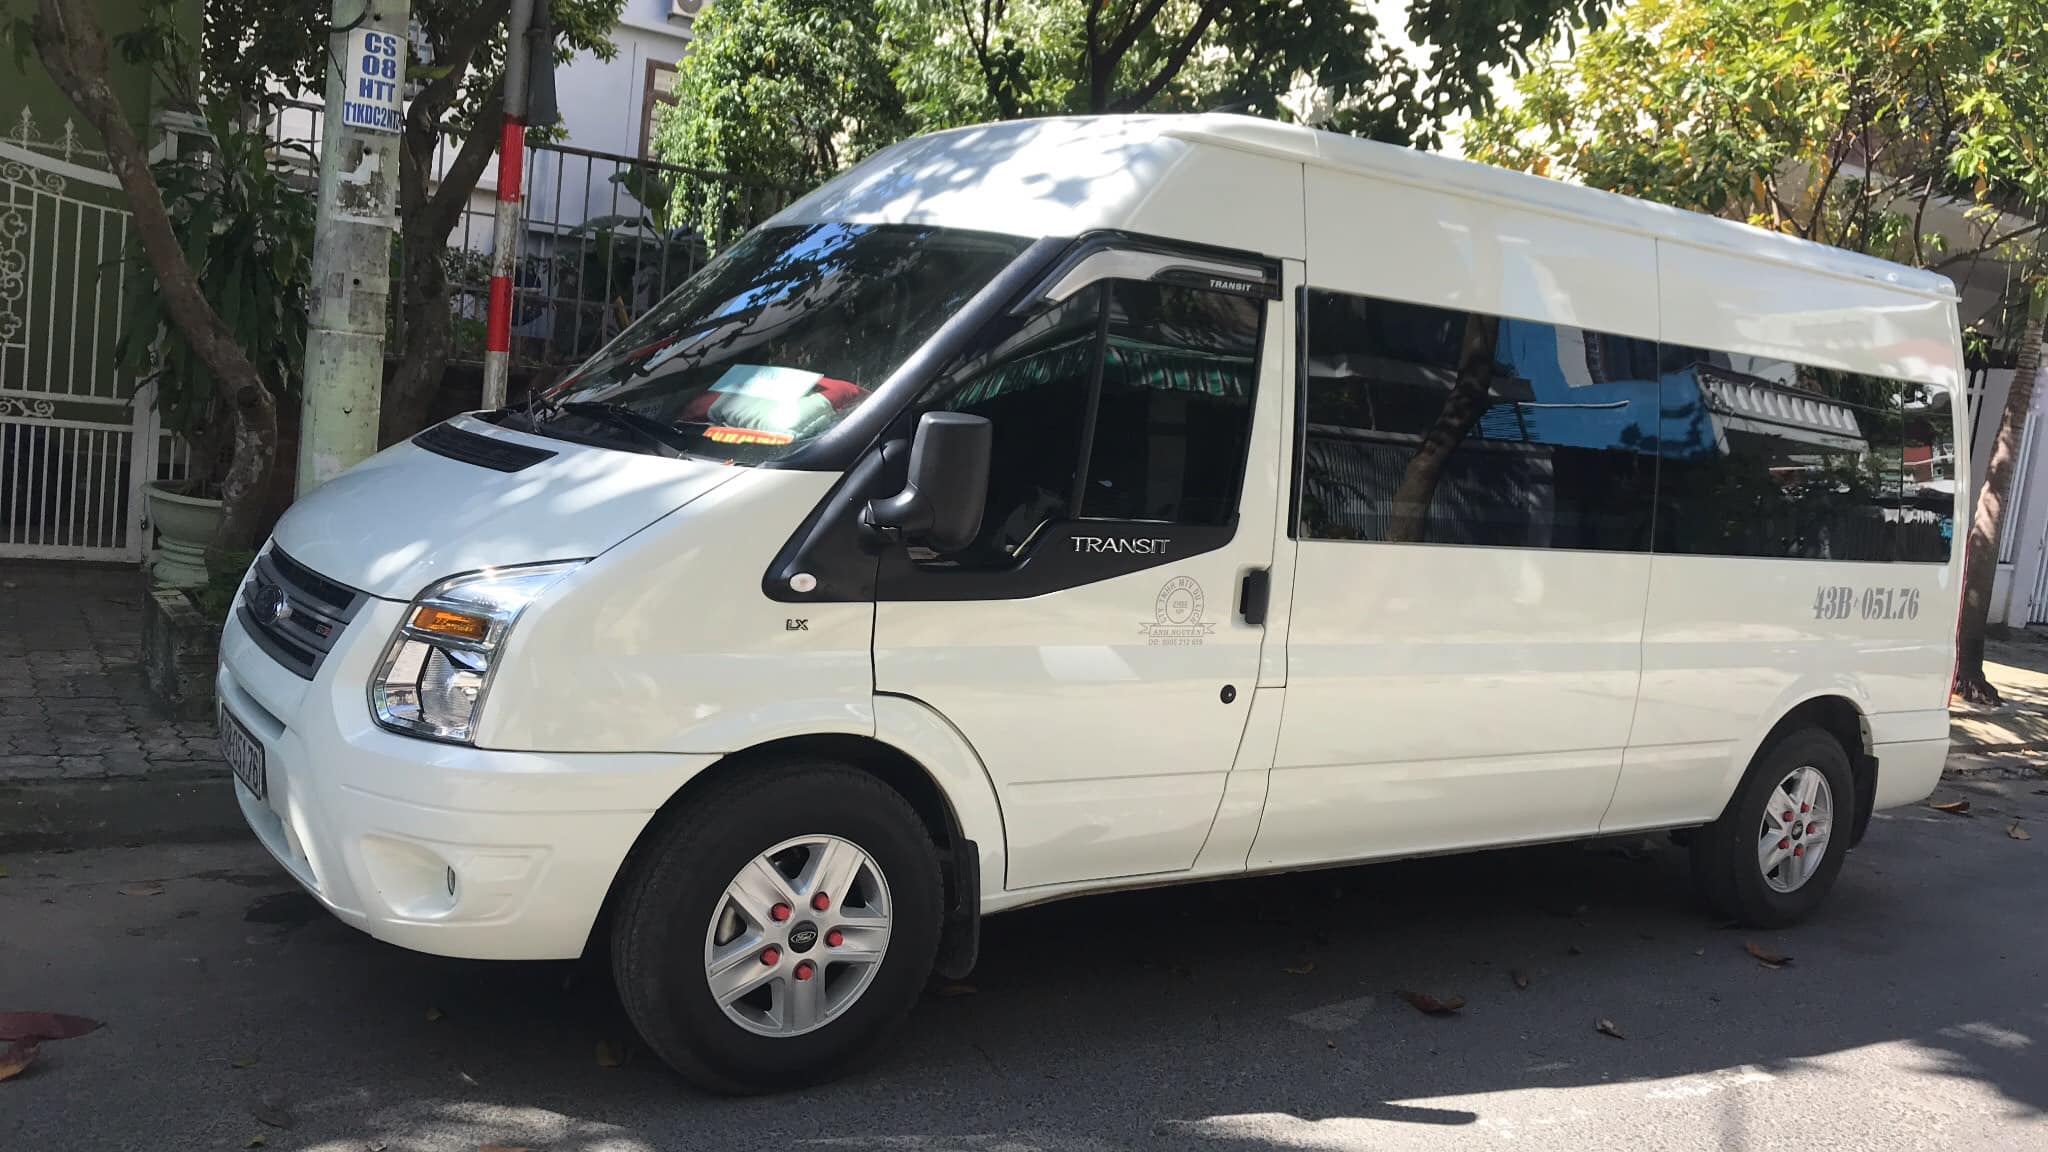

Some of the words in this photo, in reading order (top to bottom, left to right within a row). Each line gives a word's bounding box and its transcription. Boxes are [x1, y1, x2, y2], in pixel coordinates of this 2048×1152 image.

[365, 32, 396, 57] CS
[362, 55, 396, 80] 08
[359, 78, 396, 103] HTT
[1210, 279, 1252, 292] TRANSIT
[1070, 536, 1171, 554] TRANSIT
[786, 618, 809, 631] LX
